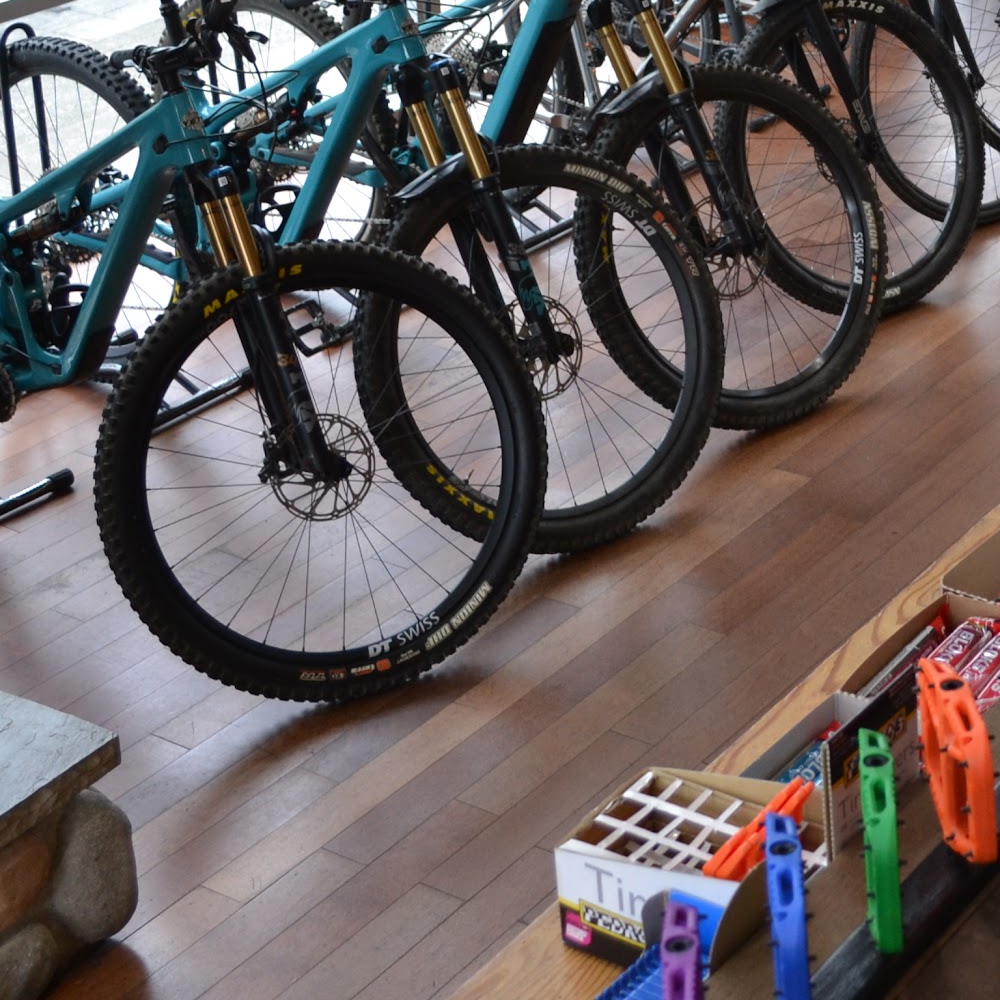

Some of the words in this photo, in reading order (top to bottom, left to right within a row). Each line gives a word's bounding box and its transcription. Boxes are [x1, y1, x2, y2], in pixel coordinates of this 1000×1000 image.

[822, 0, 885, 14] MAXXIS
[563, 163, 609, 184] MINION
[601, 191, 639, 219] SWISS
[635, 219, 657, 237] DT
[853, 231, 864, 264] SWISS
[853, 265, 864, 285] DT
[203, 264, 303, 319] MAIS
[450, 580, 493, 630] MINION
[368, 638, 393, 658] DT
[396, 611, 441, 646] SWISS
[585, 862, 646, 917] Tir
